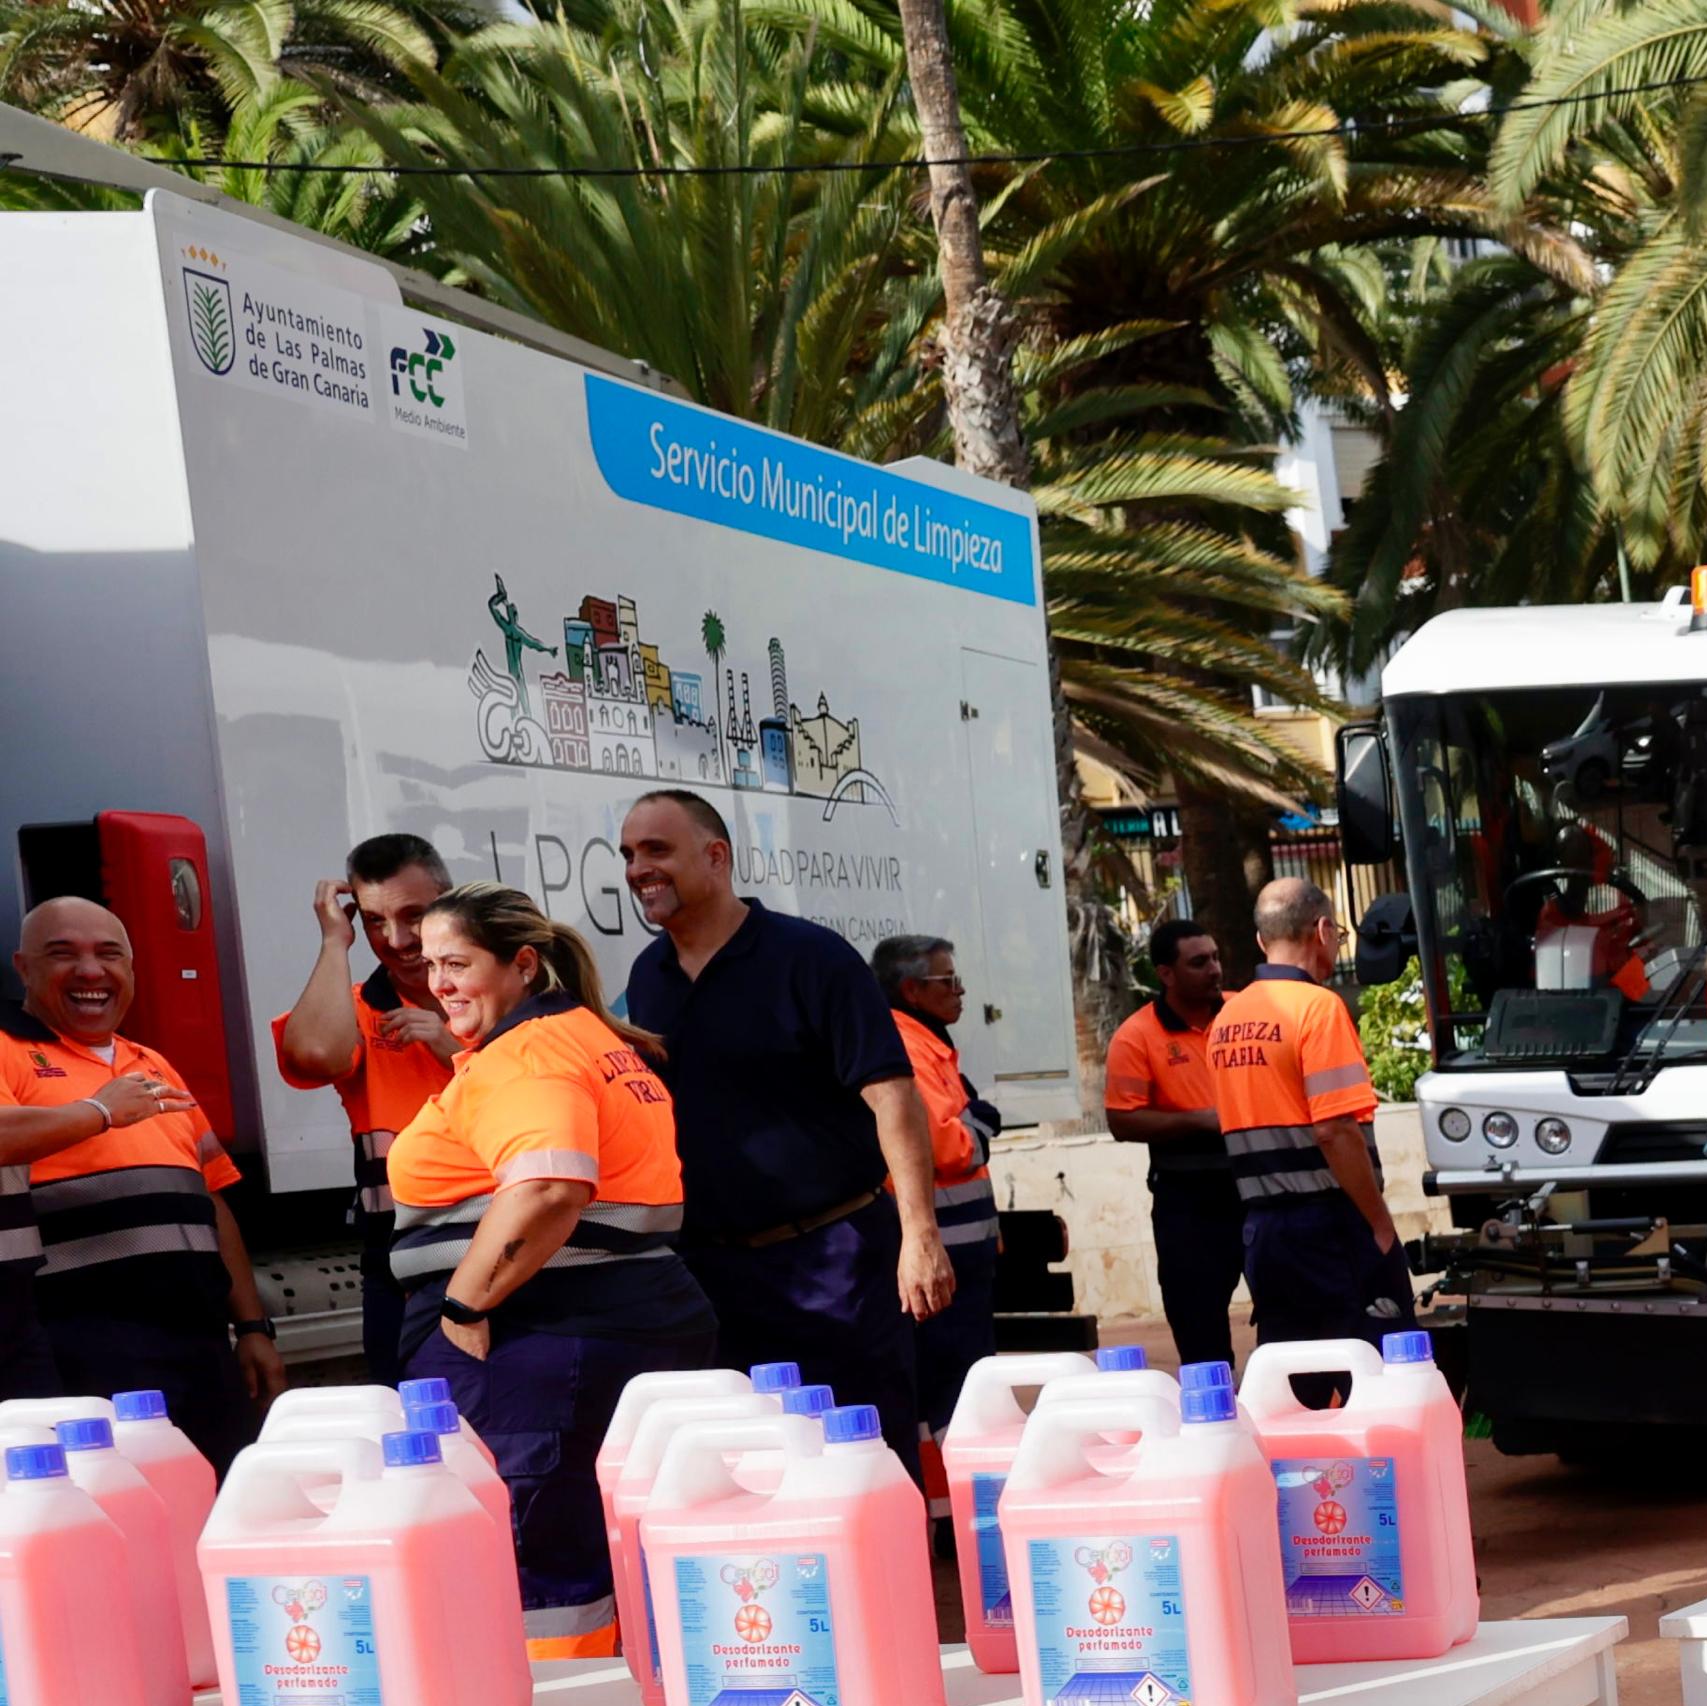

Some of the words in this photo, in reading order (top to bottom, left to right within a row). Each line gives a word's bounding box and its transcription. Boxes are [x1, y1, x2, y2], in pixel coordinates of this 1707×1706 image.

[243, 292, 363, 350] Ayuntamiento
[245, 323, 266, 349] de
[275, 333, 302, 360] Las
[311, 346, 366, 380] Palmas
[249, 353, 268, 380] de
[273, 361, 309, 391] Gran
[313, 373, 369, 409] Canaria
[394, 406, 422, 427] Medio
[424, 413, 466, 439] Ambiente
[650, 422, 756, 504] Servicio
[761, 457, 878, 545] Municipal
[882, 494, 909, 549] de
[914, 505, 1003, 574] Limpieza
[797, 850, 851, 888] PARA
[850, 854, 902, 891] VIVIR
[1293, 1534, 1372, 1546] Desodorizante
[1304, 1547, 1362, 1559] perfumado
[1066, 1626, 1153, 1639] Desodorizante
[712, 1643, 801, 1656] Desodorizante
[1078, 1640, 1143, 1653] perfumado
[264, 1664, 350, 1676] Desodorizante
[725, 1657, 791, 1671] perfumado
[276, 1677, 339, 1689] perfumado
